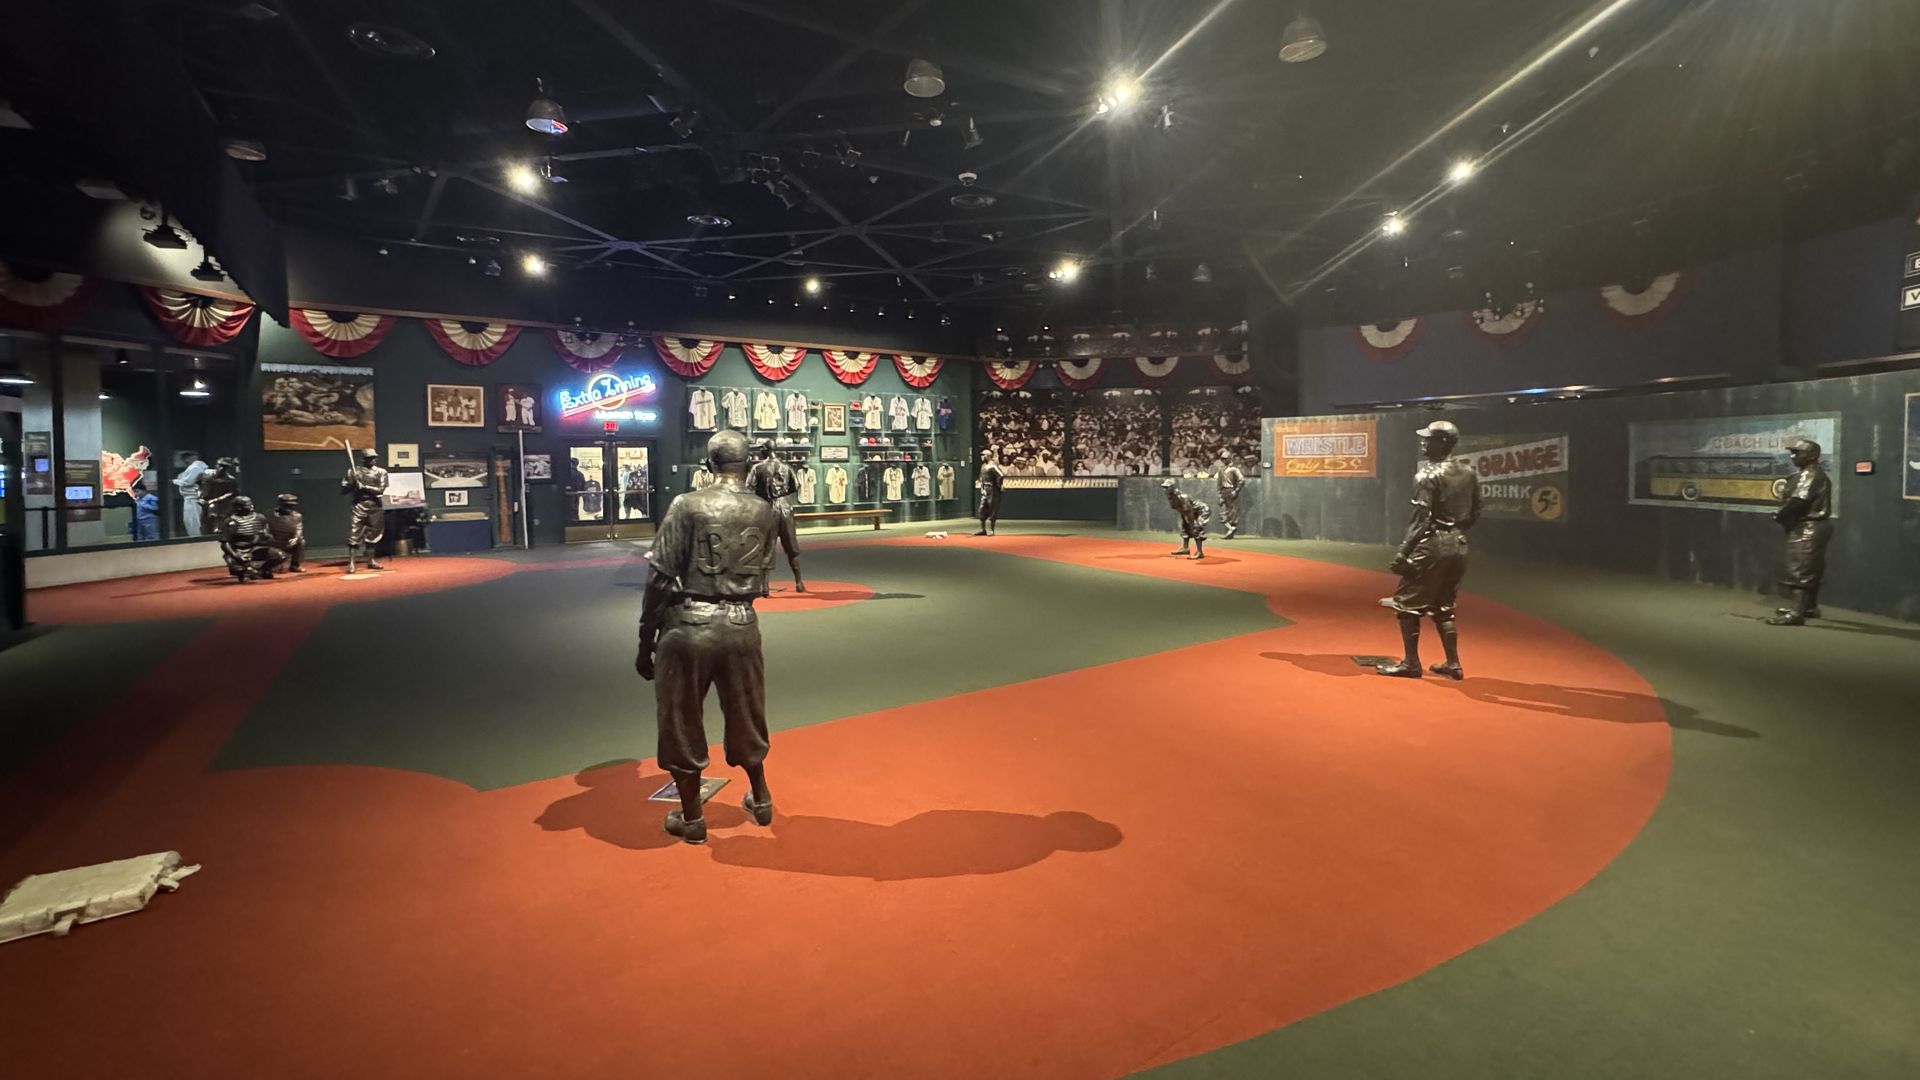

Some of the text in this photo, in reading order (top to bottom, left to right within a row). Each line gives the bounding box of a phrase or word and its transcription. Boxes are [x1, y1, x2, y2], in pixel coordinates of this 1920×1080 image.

[560, 374, 651, 410] Extra Inning
[1285, 436, 1366, 455] WHISTLE
[1286, 458, 1320, 473] Only
[1477, 444, 1561, 477] ORANGE
[1481, 483, 1532, 499] DRINK
